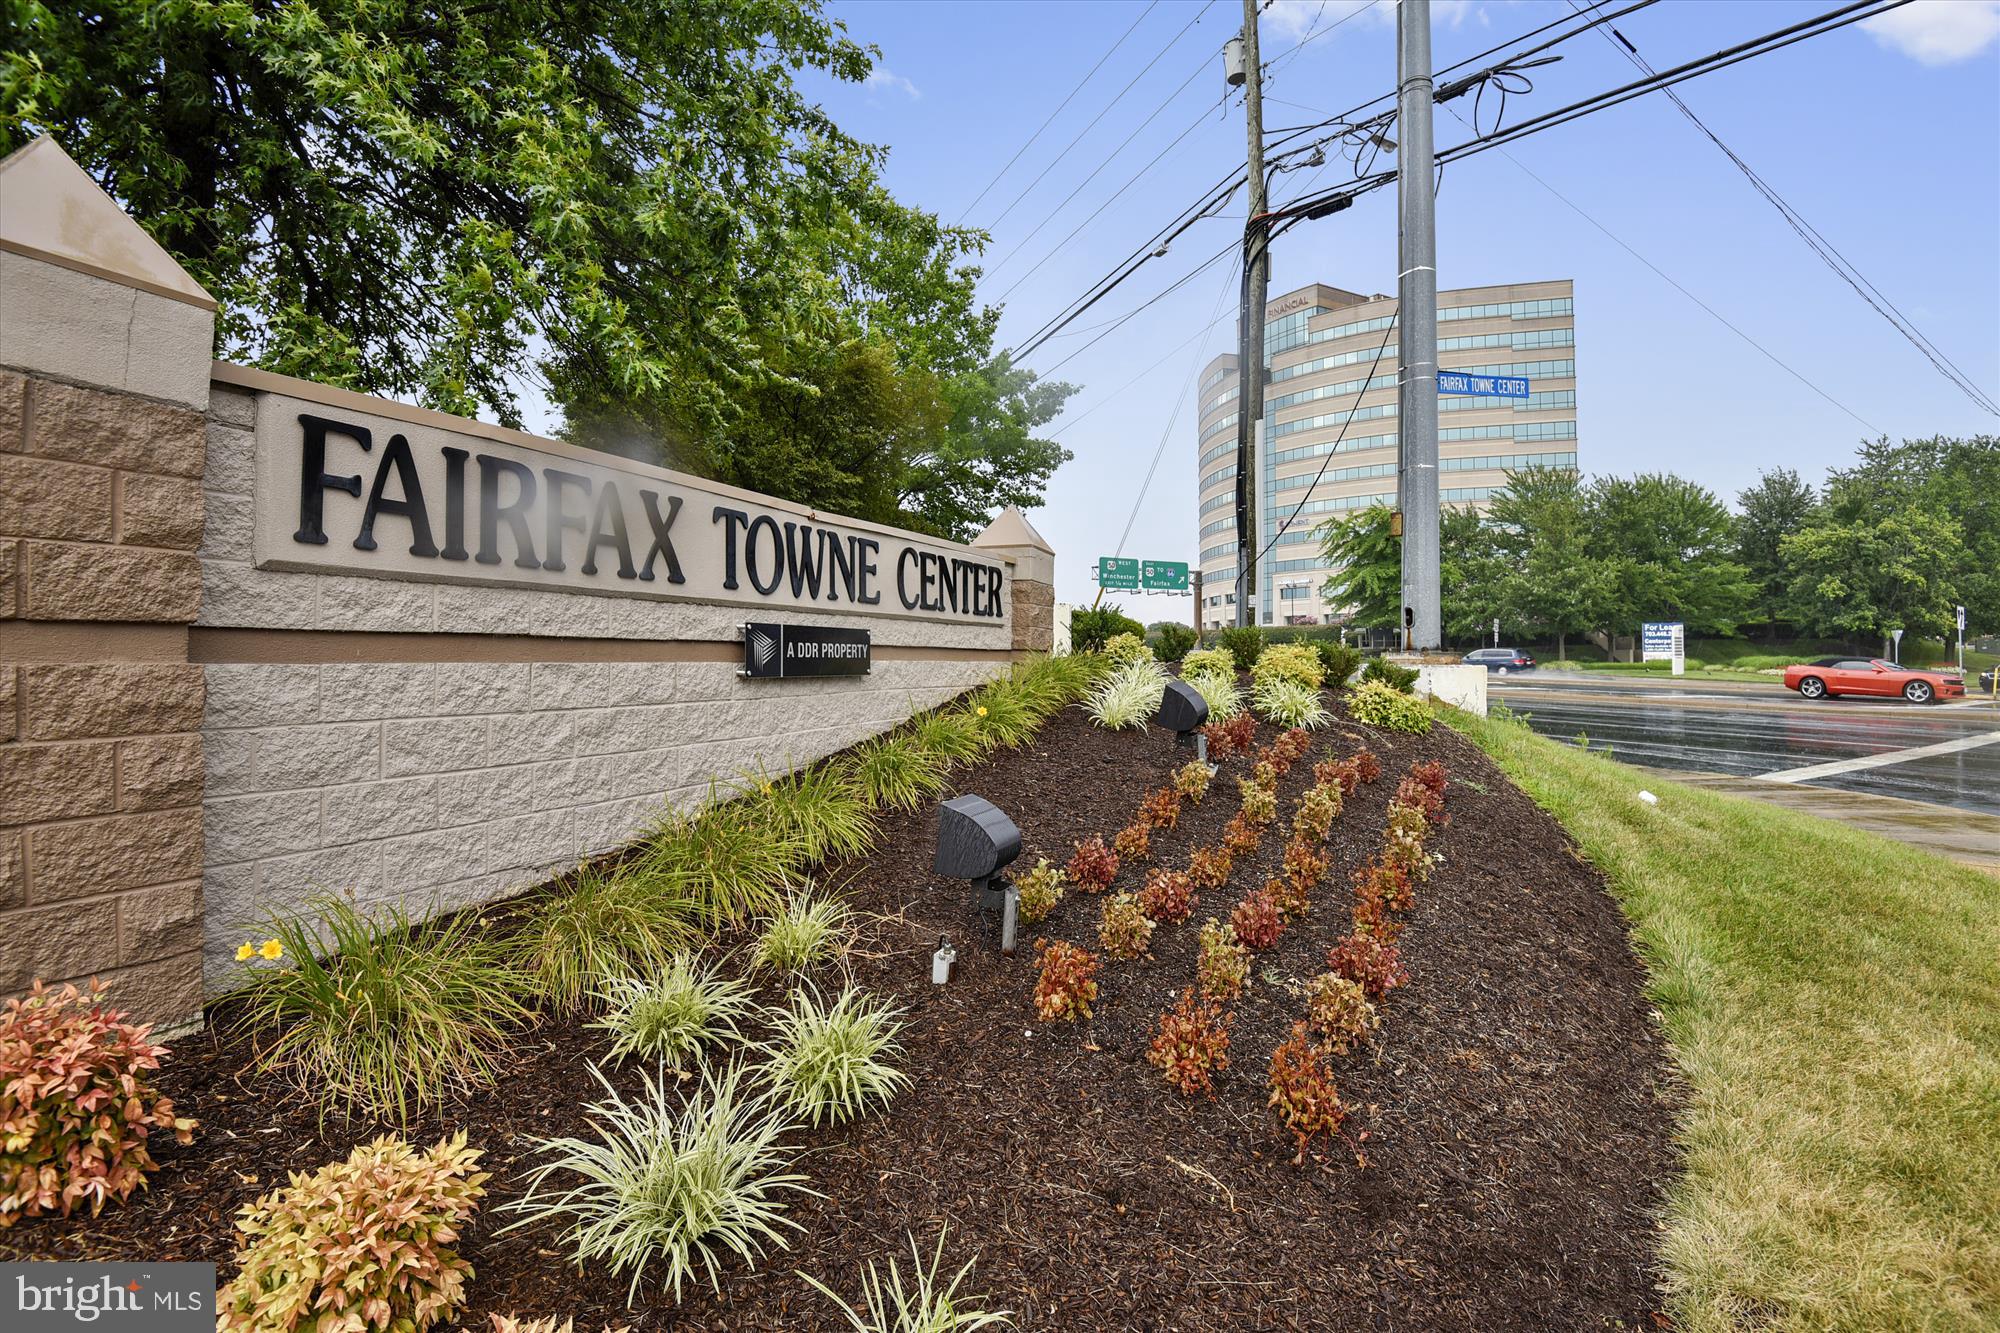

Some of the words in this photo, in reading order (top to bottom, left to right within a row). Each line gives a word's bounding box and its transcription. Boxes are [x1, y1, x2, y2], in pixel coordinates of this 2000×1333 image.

[1267, 296, 1309, 317] FINANCIAL
[1440, 376, 1468, 391] FAIRFAX
[1470, 378, 1495, 393] TOWNE
[1498, 380, 1526, 395] CENTER
[293, 414, 686, 585] FAIRFAX
[712, 506, 881, 606] TOWNE
[897, 546, 1004, 618] CENTER
[787, 642, 794, 658] A
[797, 642, 819, 658] DDR
[822, 643, 868, 658] PROPERTY
